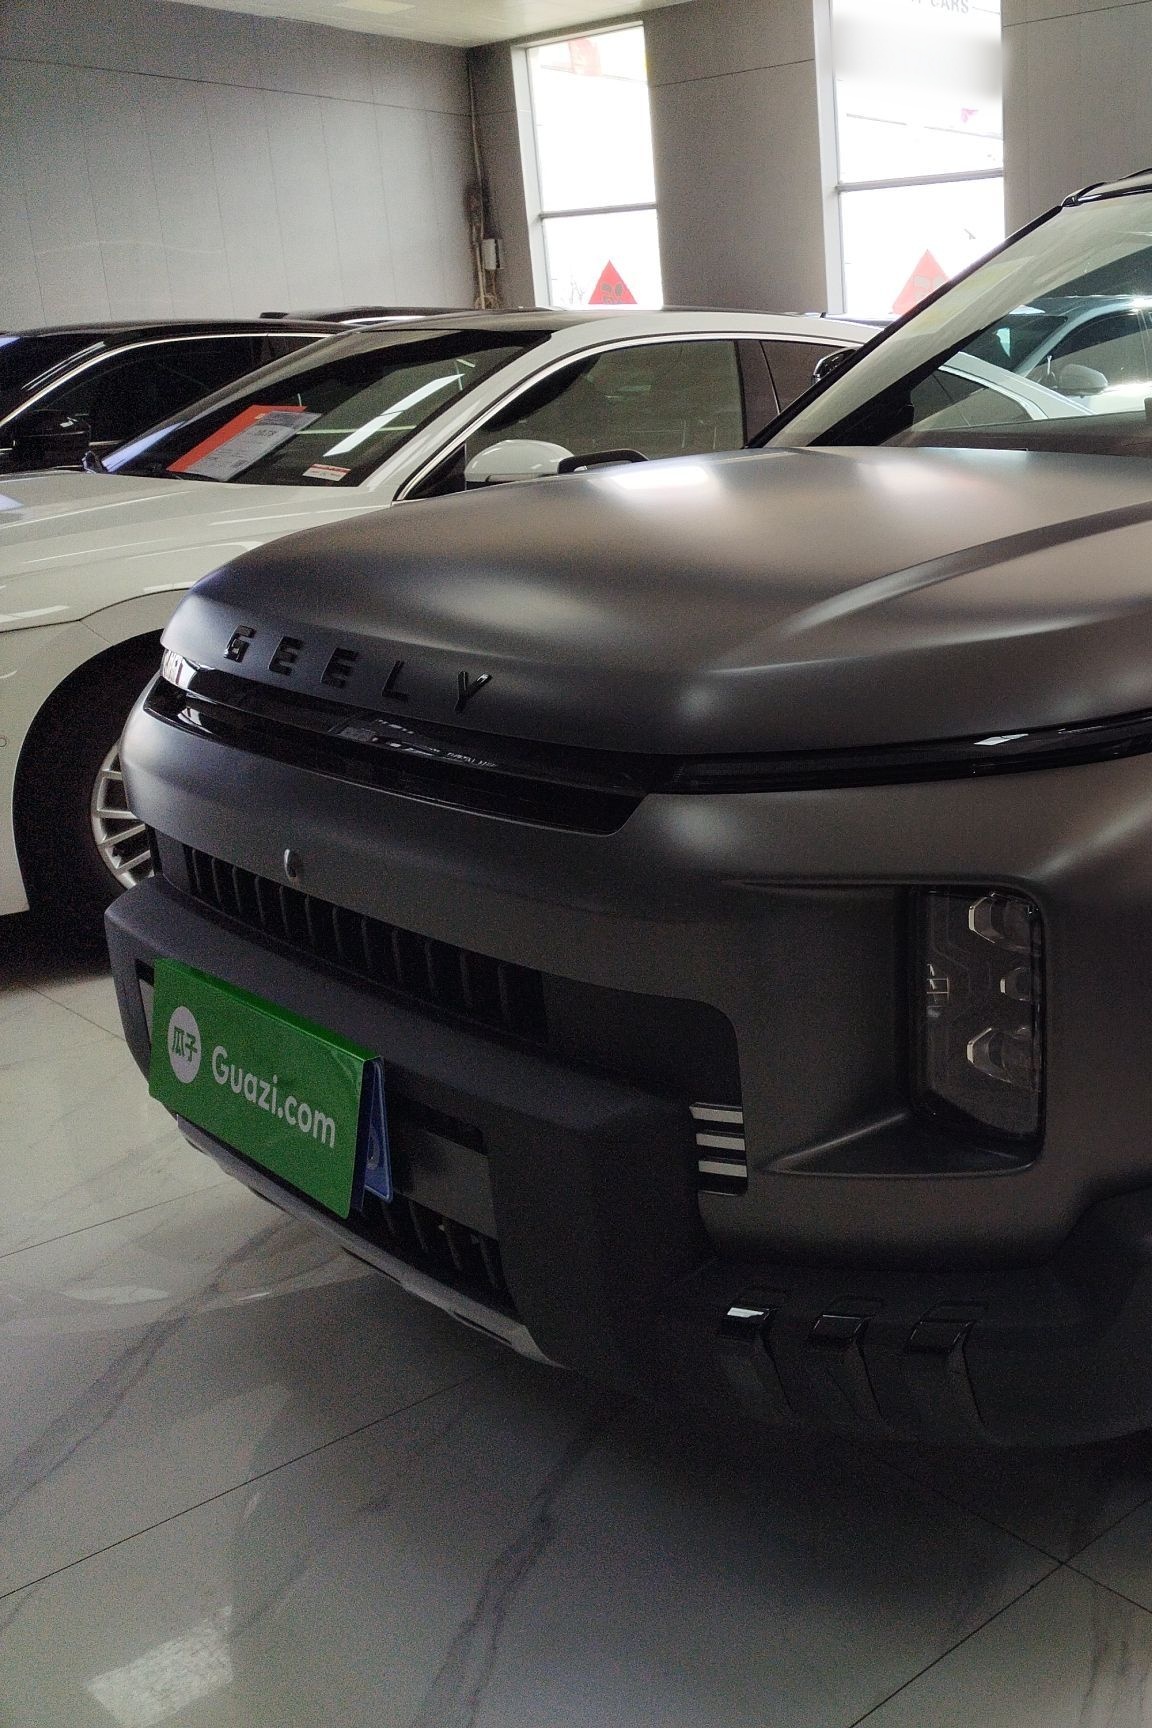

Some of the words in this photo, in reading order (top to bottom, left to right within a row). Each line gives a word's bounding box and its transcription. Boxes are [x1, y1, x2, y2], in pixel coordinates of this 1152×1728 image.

[224, 625, 492, 711] GEELY
[172, 1026, 198, 1063] 瓜子
[212, 1045, 336, 1148] Guazi.com
